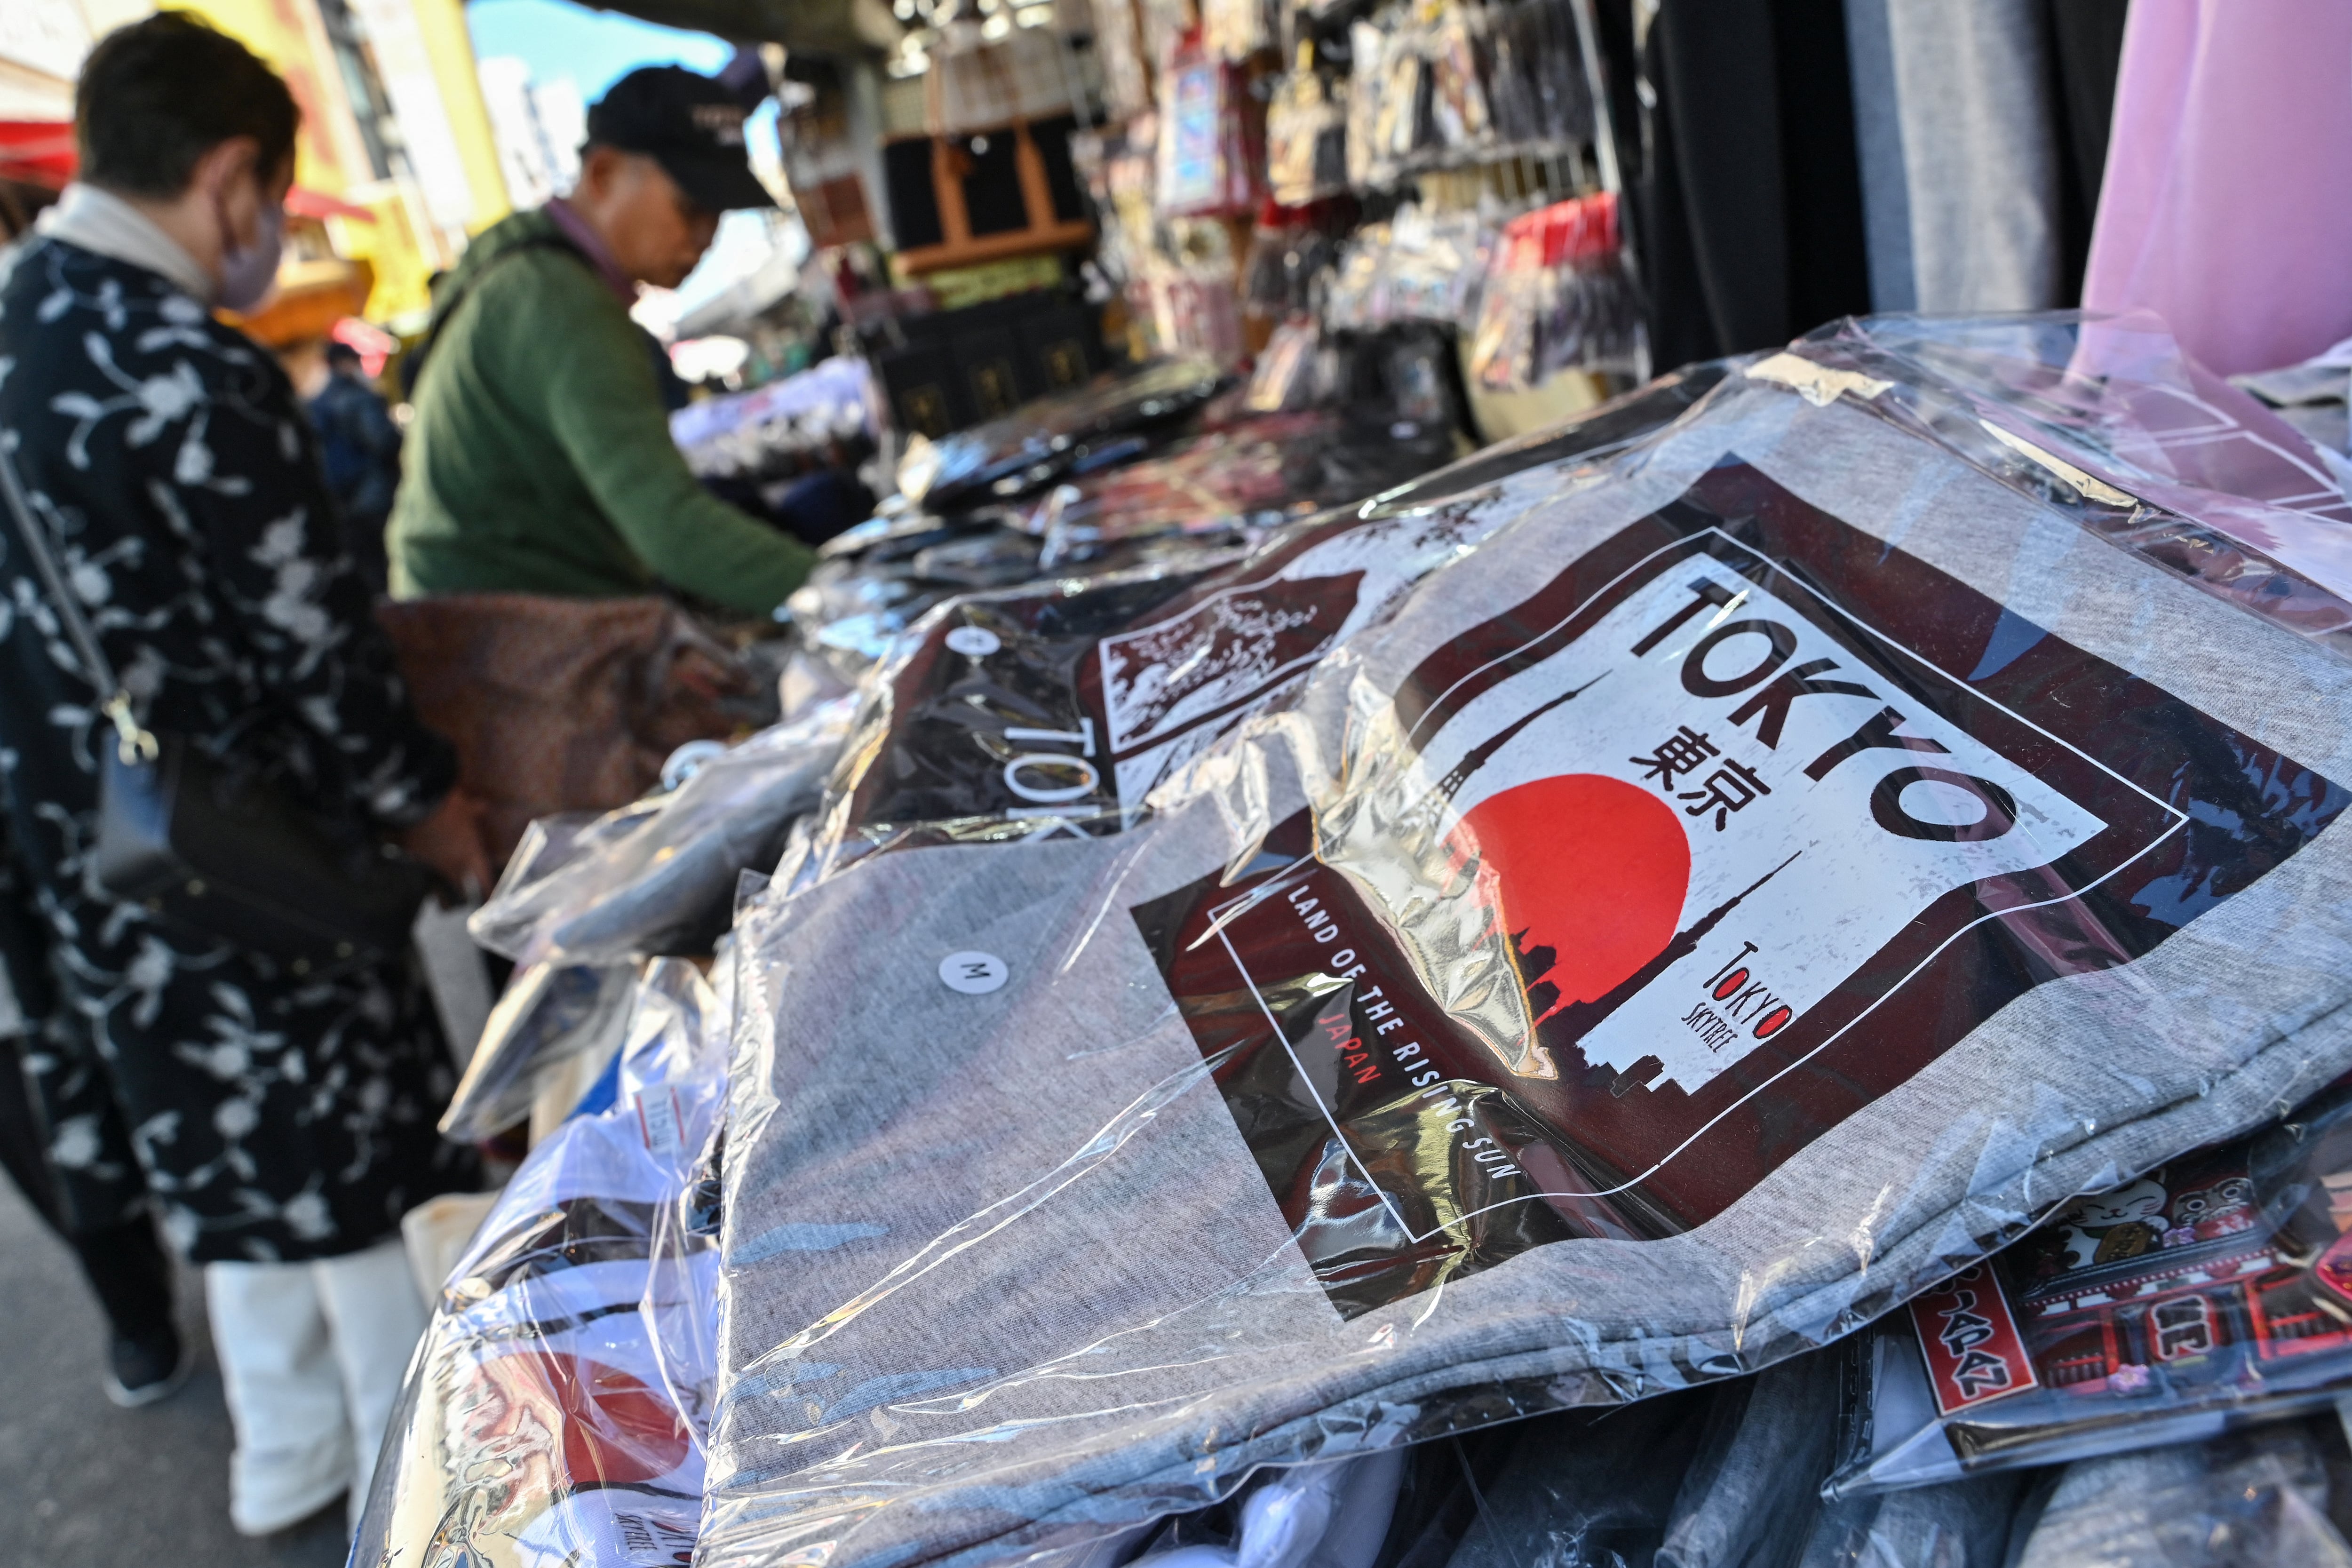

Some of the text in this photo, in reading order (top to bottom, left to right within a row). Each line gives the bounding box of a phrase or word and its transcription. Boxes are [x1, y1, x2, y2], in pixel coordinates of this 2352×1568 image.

[1630, 576, 2018, 842] TOKYO
[1629, 725, 1772, 832] 東京
[960, 963, 991, 979] M
[1702, 941, 1793, 1040] TOKYO
[1287, 885, 1522, 1180] LAND OF THE RISING SUN
[1319, 1014, 1382, 1084] JAPAN
[1681, 1002, 1738, 1053] SKYTREE
[1937, 1289, 2012, 1401] JAPAN
[615, 1513, 657, 1550] SKYTREE
